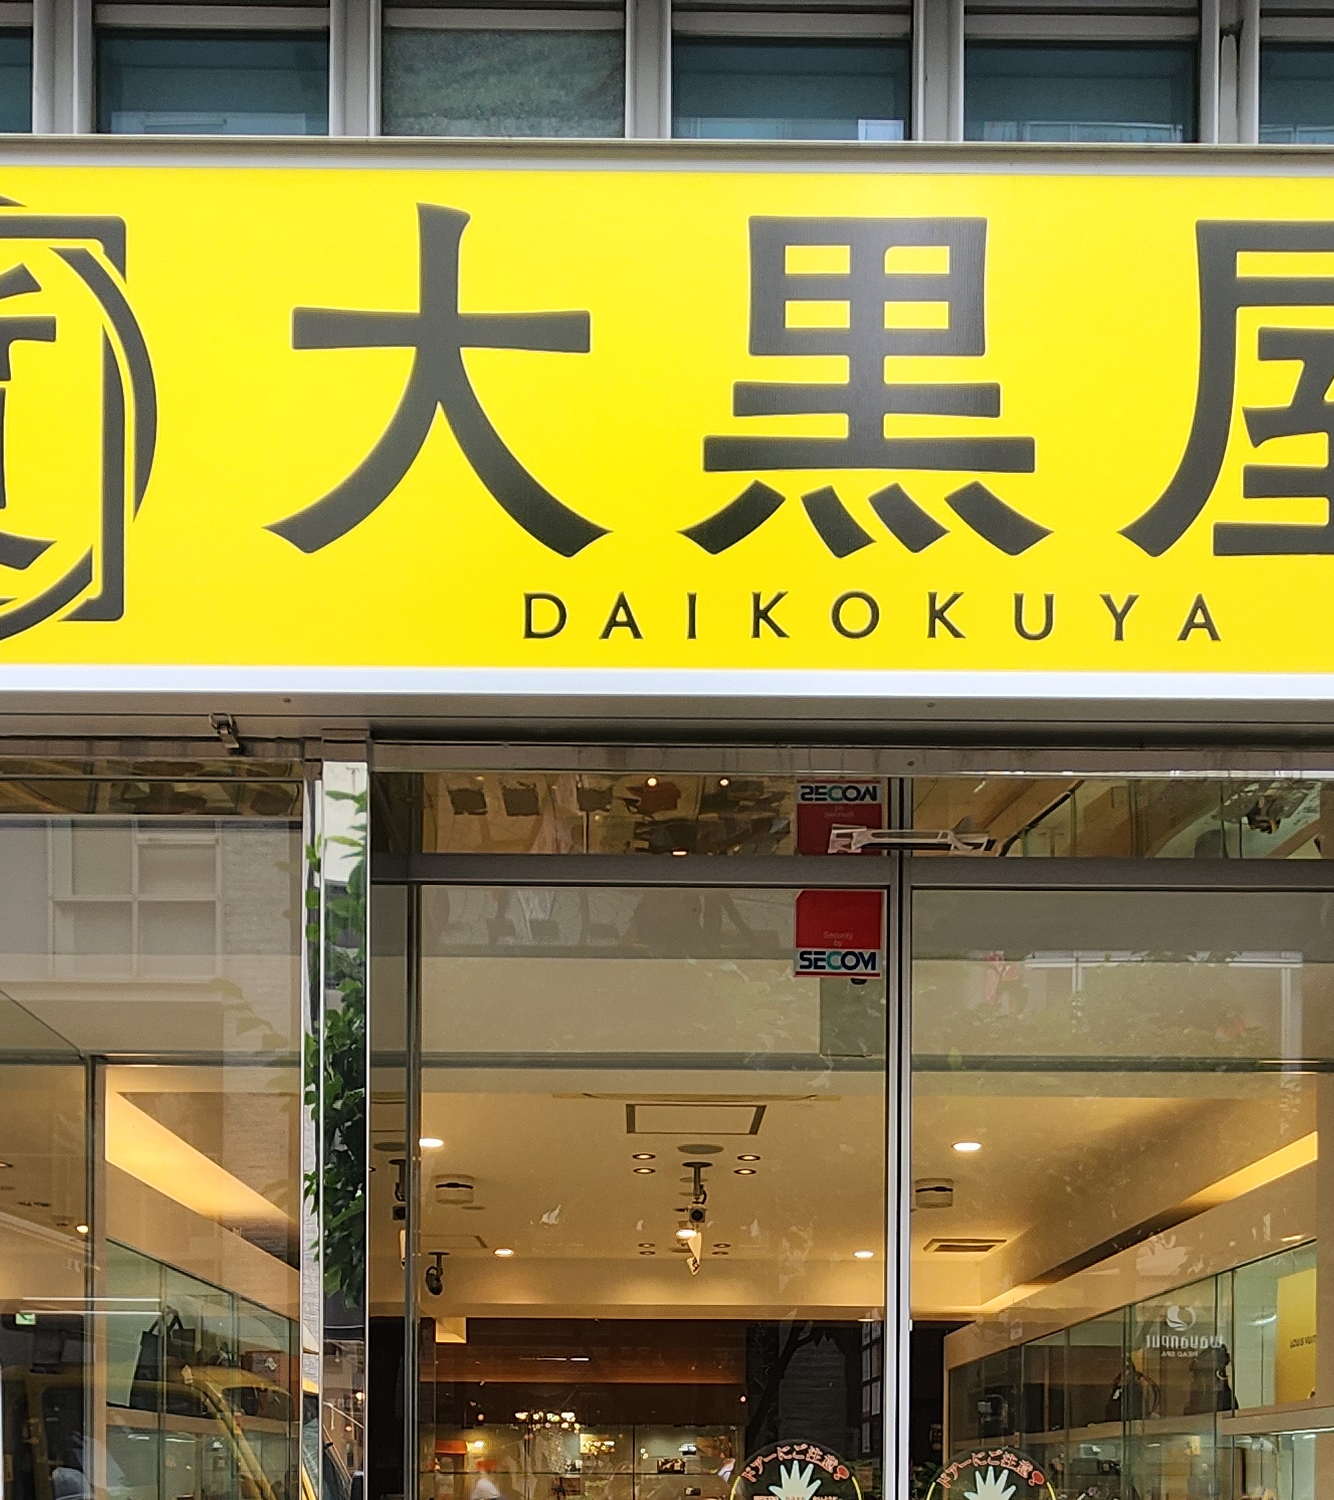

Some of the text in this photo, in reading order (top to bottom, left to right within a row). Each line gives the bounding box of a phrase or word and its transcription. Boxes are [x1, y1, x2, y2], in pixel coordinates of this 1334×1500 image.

[523, 591, 1223, 641] DAIKOKUYA
[823, 930, 854, 941] Security
[833, 939, 843, 948] by
[799, 950, 877, 971] SECOM
